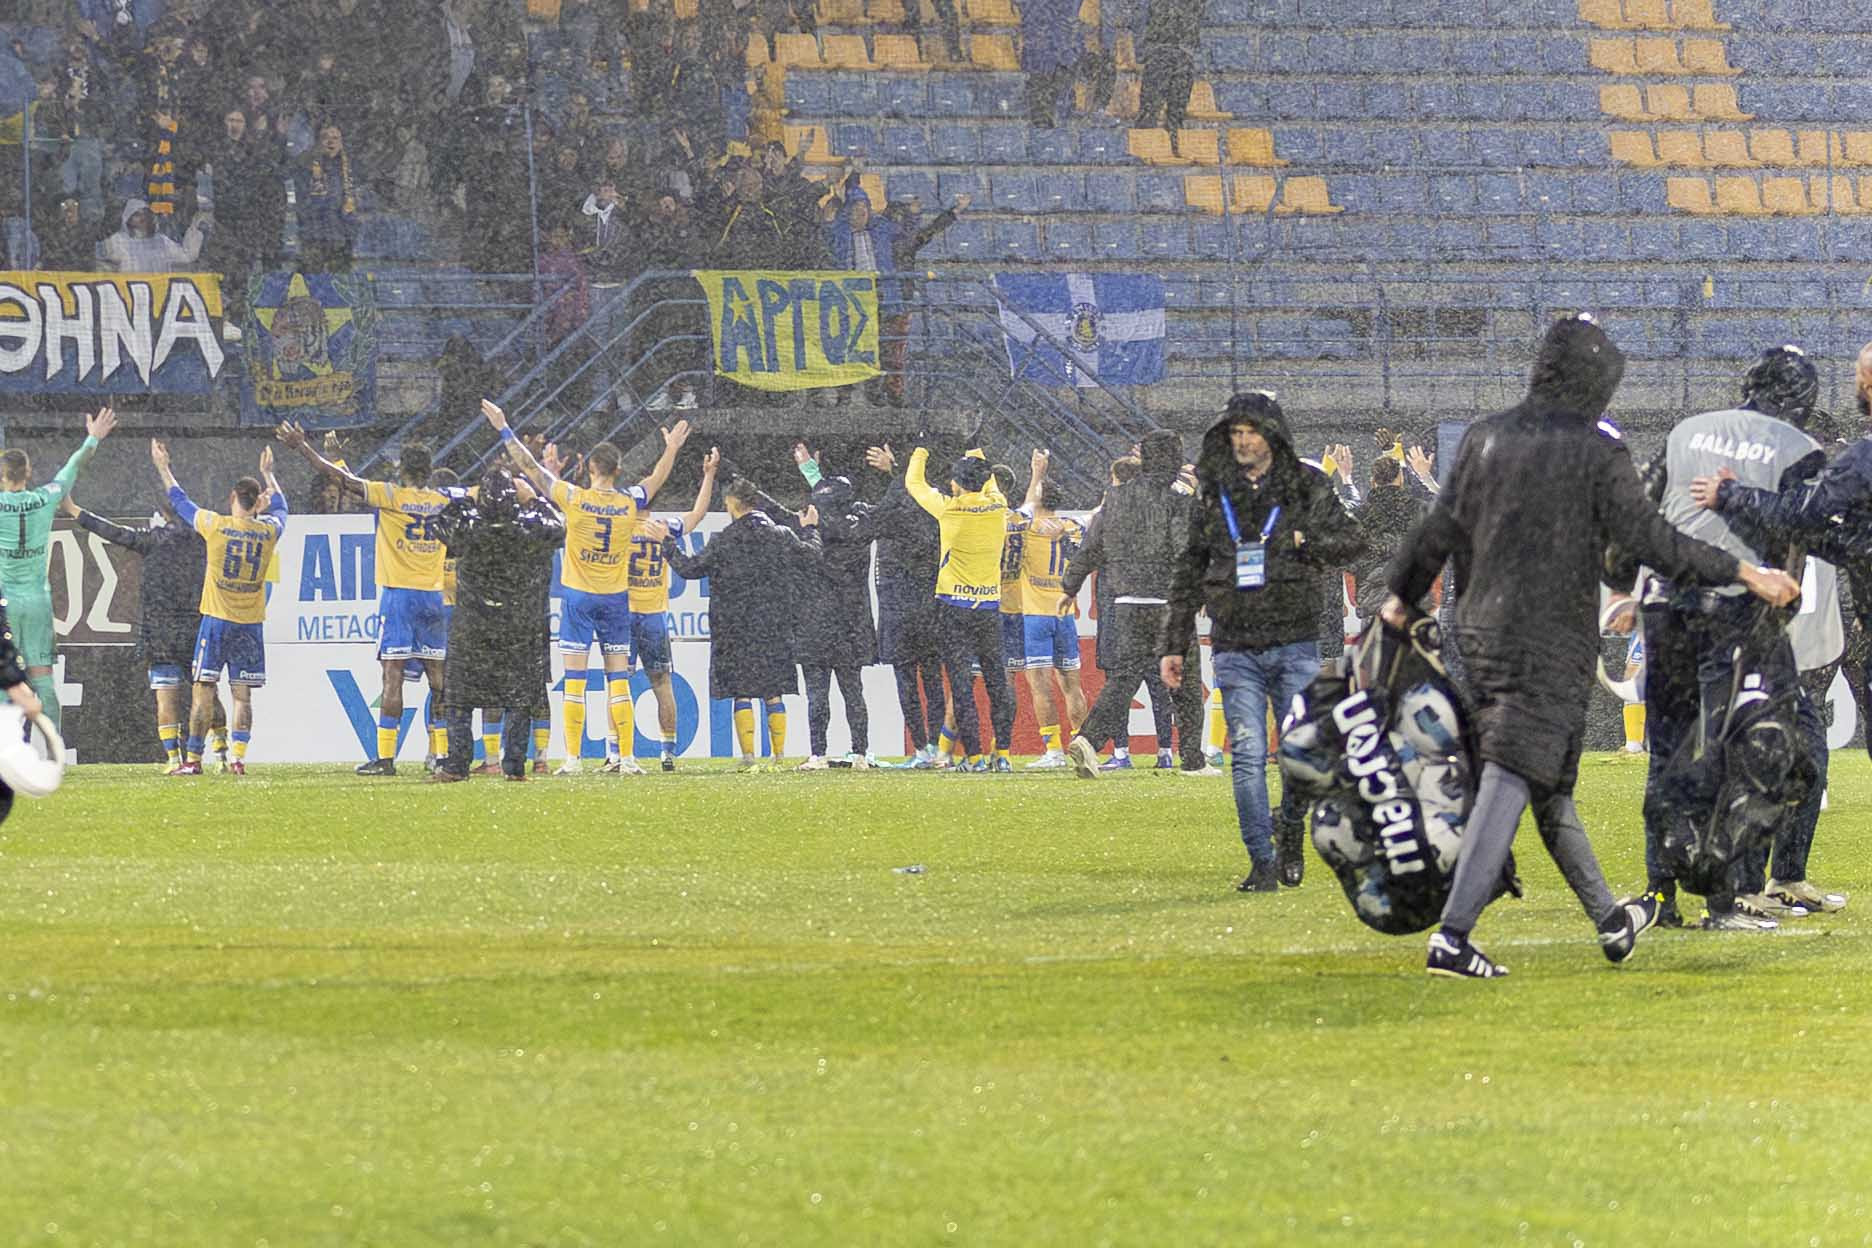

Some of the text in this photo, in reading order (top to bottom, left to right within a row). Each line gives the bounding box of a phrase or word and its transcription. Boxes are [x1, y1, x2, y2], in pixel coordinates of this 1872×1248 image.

[721, 275, 876, 373] ΑΡΓΟΣ
[1689, 433, 1776, 464] BALL BOY
[593, 517, 612, 552] 3
[1332, 690, 1425, 875] macron
